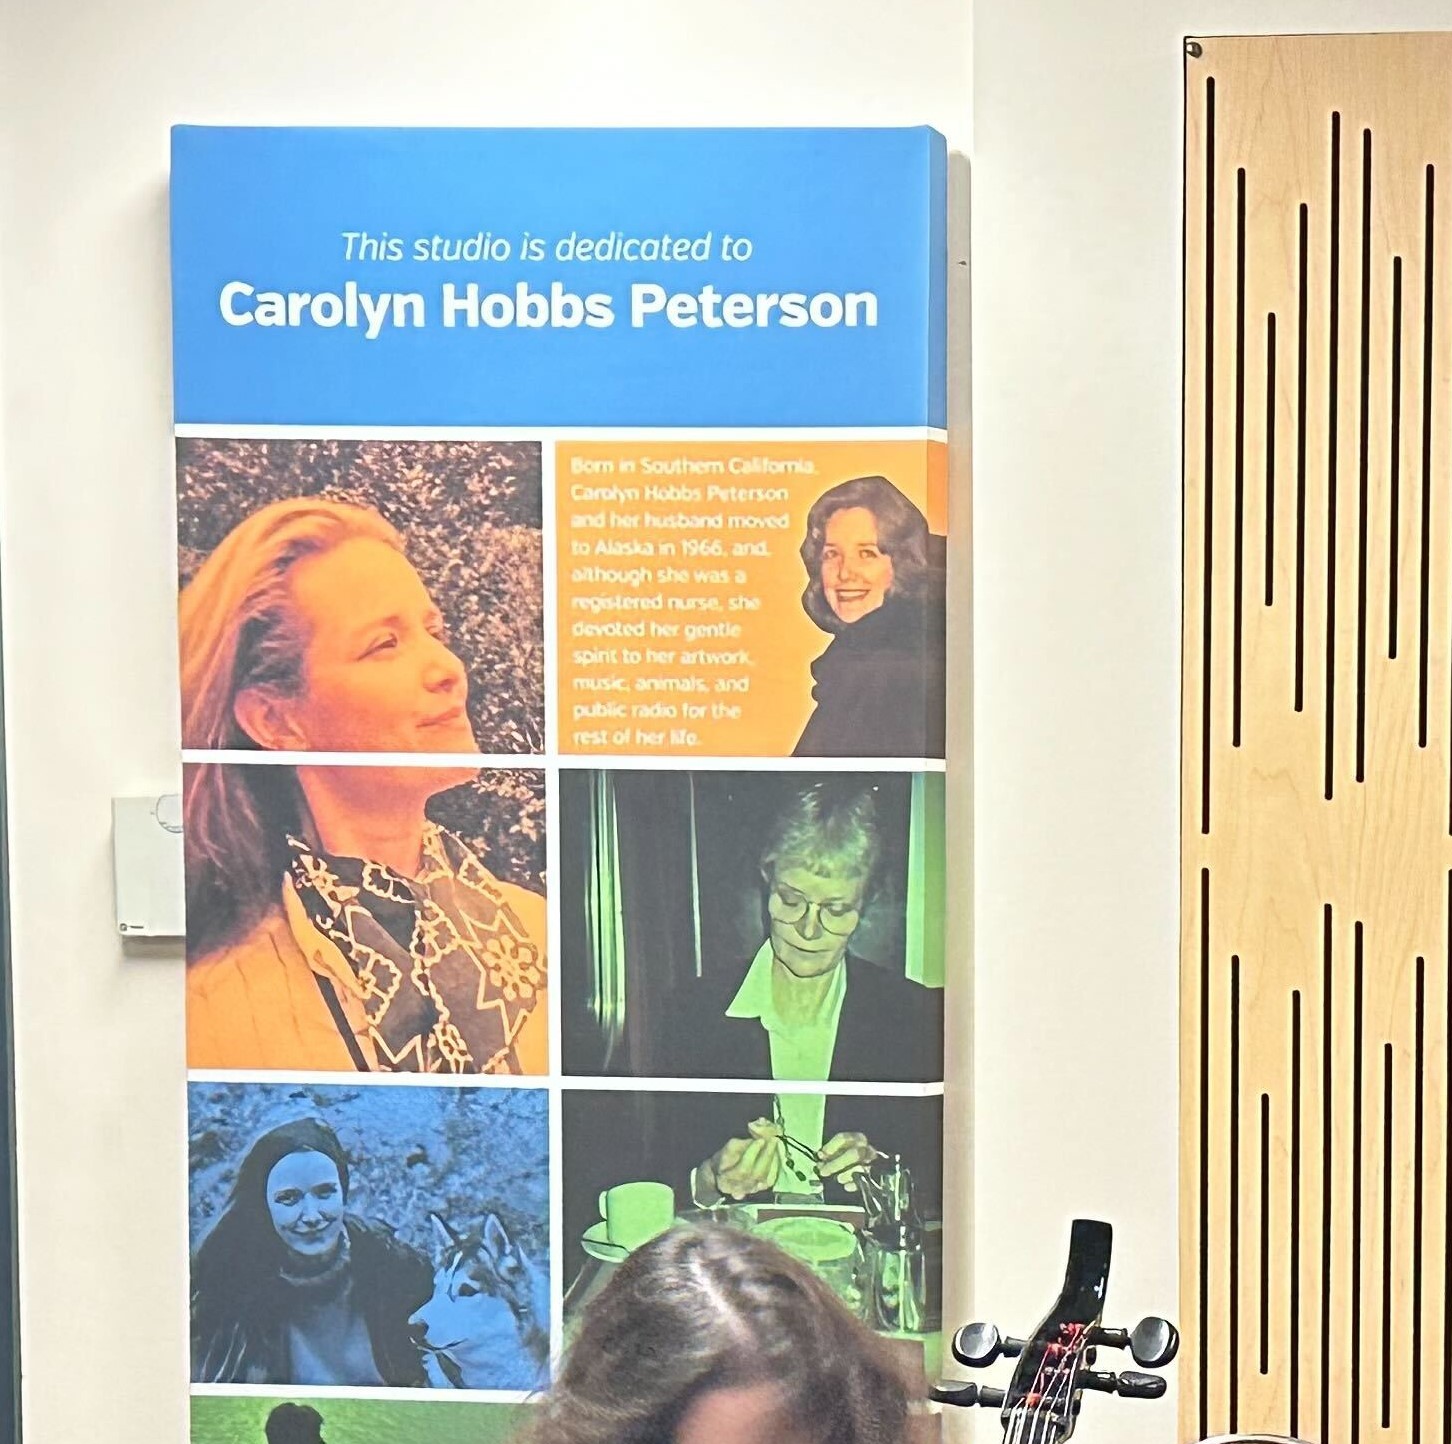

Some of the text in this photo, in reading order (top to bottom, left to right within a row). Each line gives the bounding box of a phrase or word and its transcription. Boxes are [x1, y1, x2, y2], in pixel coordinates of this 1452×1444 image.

[342, 231, 753, 261] This studio is dedicated to
[219, 281, 878, 340] Carolyn Hobbs Peterson
[570, 455, 615, 474] Born
[618, 456, 637, 473] in
[640, 455, 725, 474] Southern
[570, 483, 789, 503] Carolyn Hobbs Peterson
[570, 511, 790, 529] and her husband moved
[571, 540, 591, 555] to
[594, 539, 655, 556] Alaska
[658, 540, 676, 556] in
[571, 566, 747, 587] although she was a
[571, 593, 664, 613] registered
[727, 595, 761, 610] she
[571, 620, 742, 641] devoted her gentle
[572, 647, 618, 666] spirit
[622, 647, 642, 664] to
[645, 647, 676, 664] her
[714, 675, 750, 692] and
[573, 701, 742, 720] public radio for the
[573, 728, 608, 744] rest
[612, 727, 631, 744] of
[635, 728, 666, 745] her
